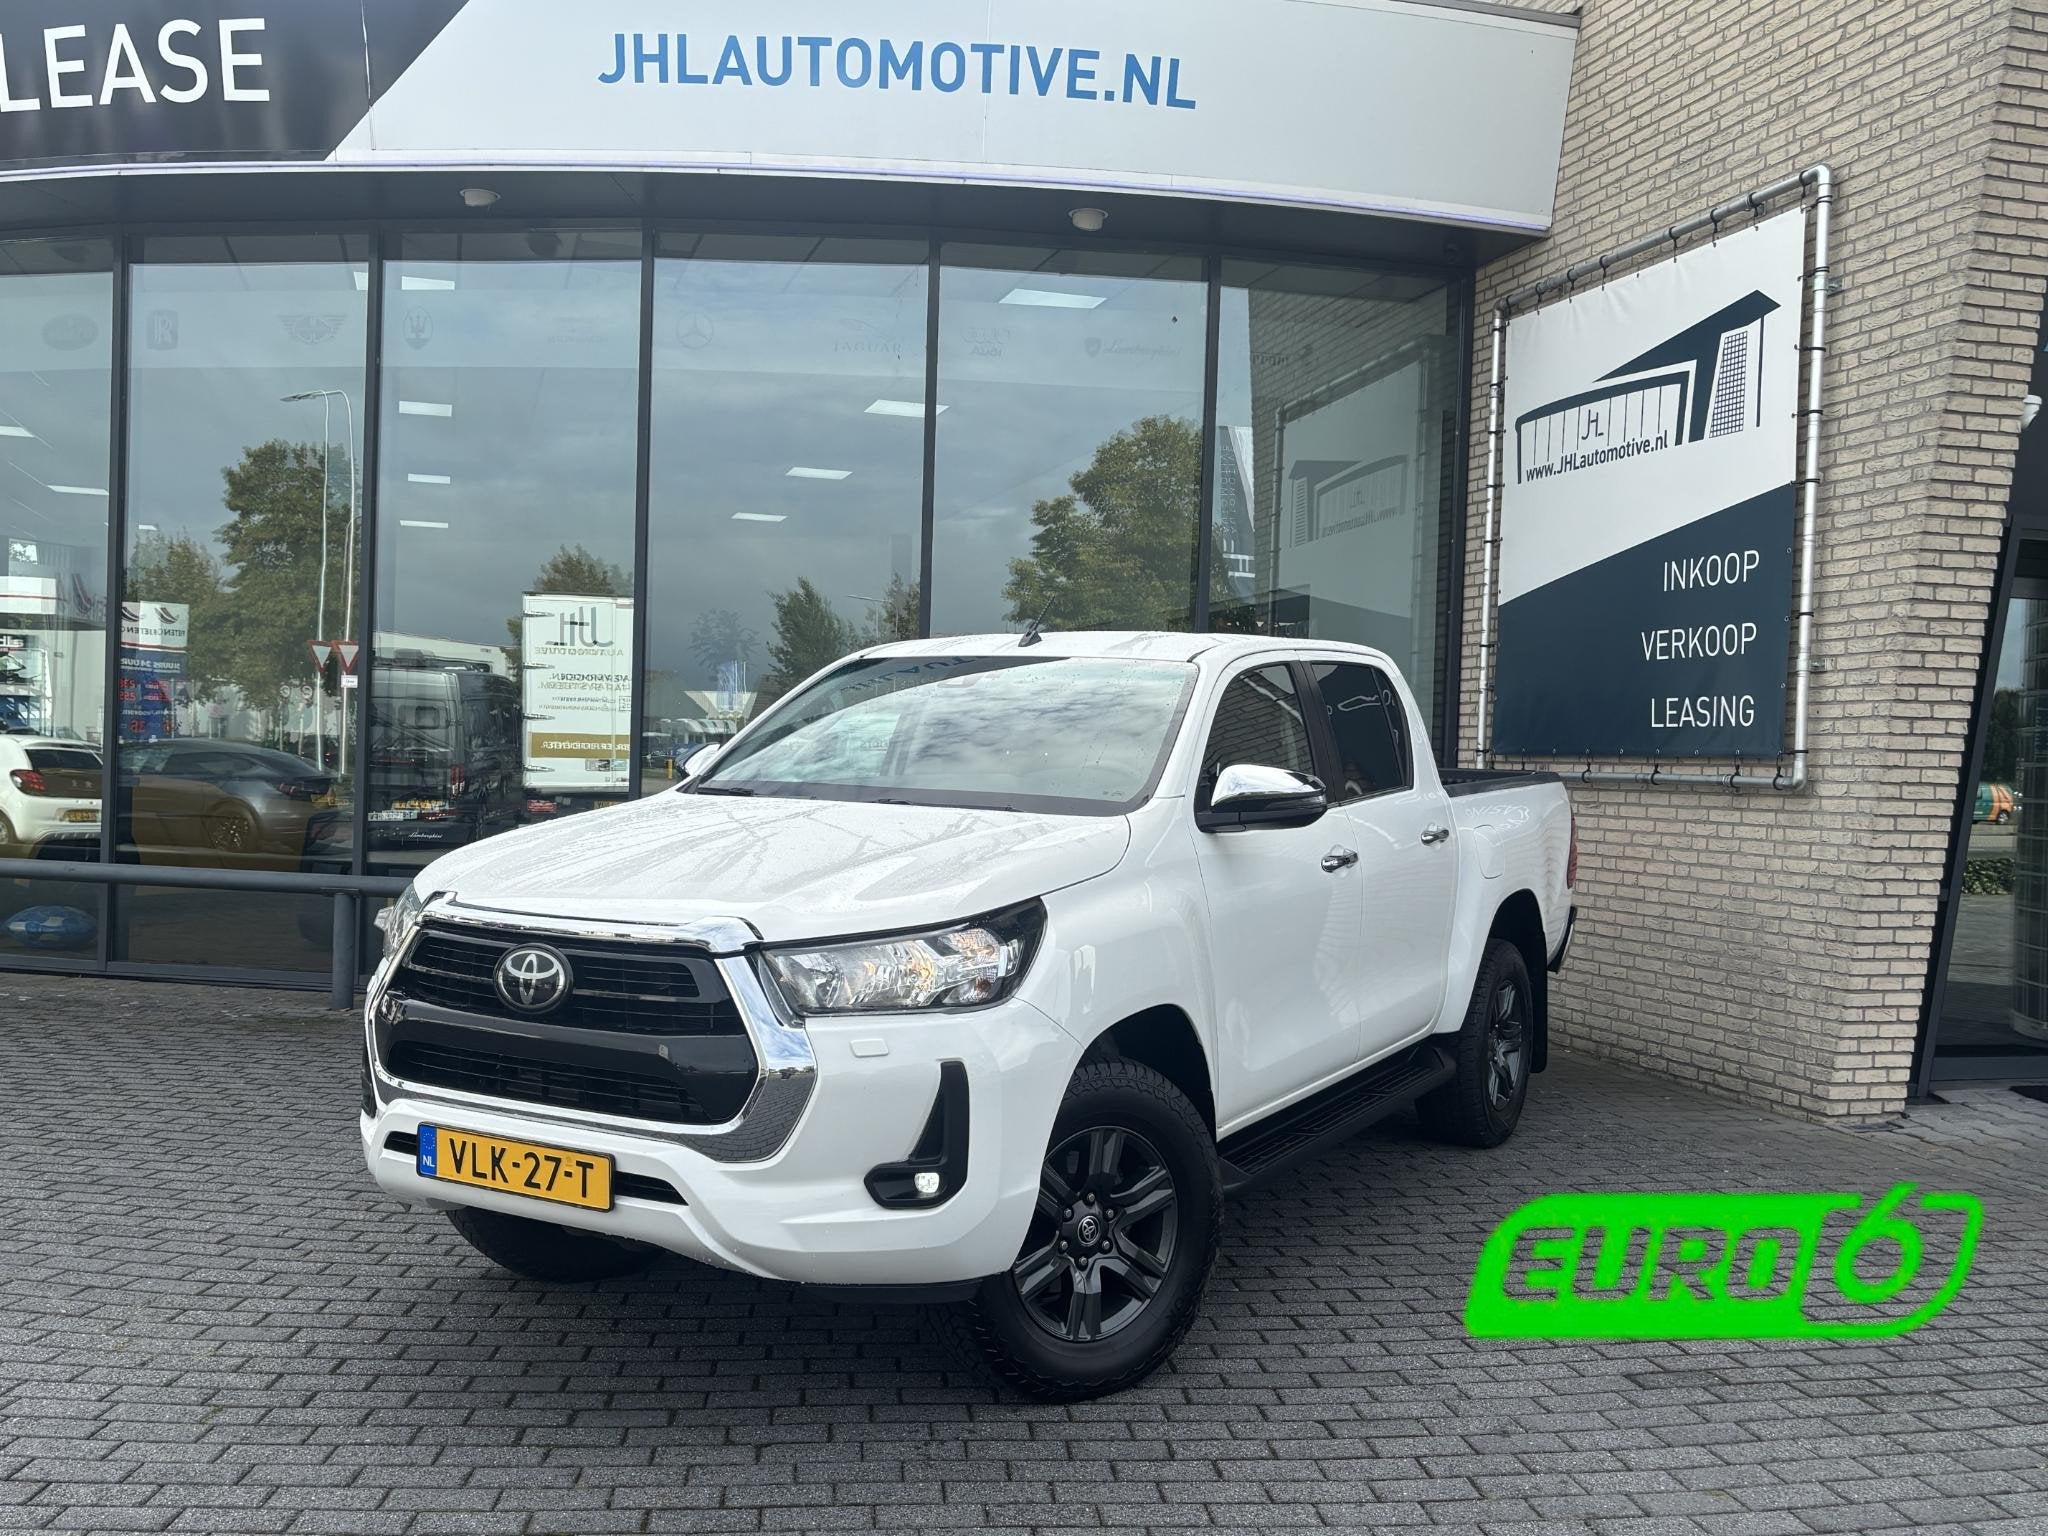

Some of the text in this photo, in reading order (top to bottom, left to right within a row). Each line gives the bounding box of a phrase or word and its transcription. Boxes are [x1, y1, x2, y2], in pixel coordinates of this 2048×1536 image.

[0, 18, 270, 112] LEASE
[598, 33, 1196, 109] JHLAUTOMOTIVE.NL
[1581, 408, 1604, 440] JHL
[1526, 430, 1668, 482] www.JHLautomotive.nl
[1664, 550, 1760, 592] INKOOP
[1641, 622, 1757, 661] VERKOOP
[1651, 695, 1755, 728] LEASING
[422, 1137, 594, 1198] NL VLK-27-T
